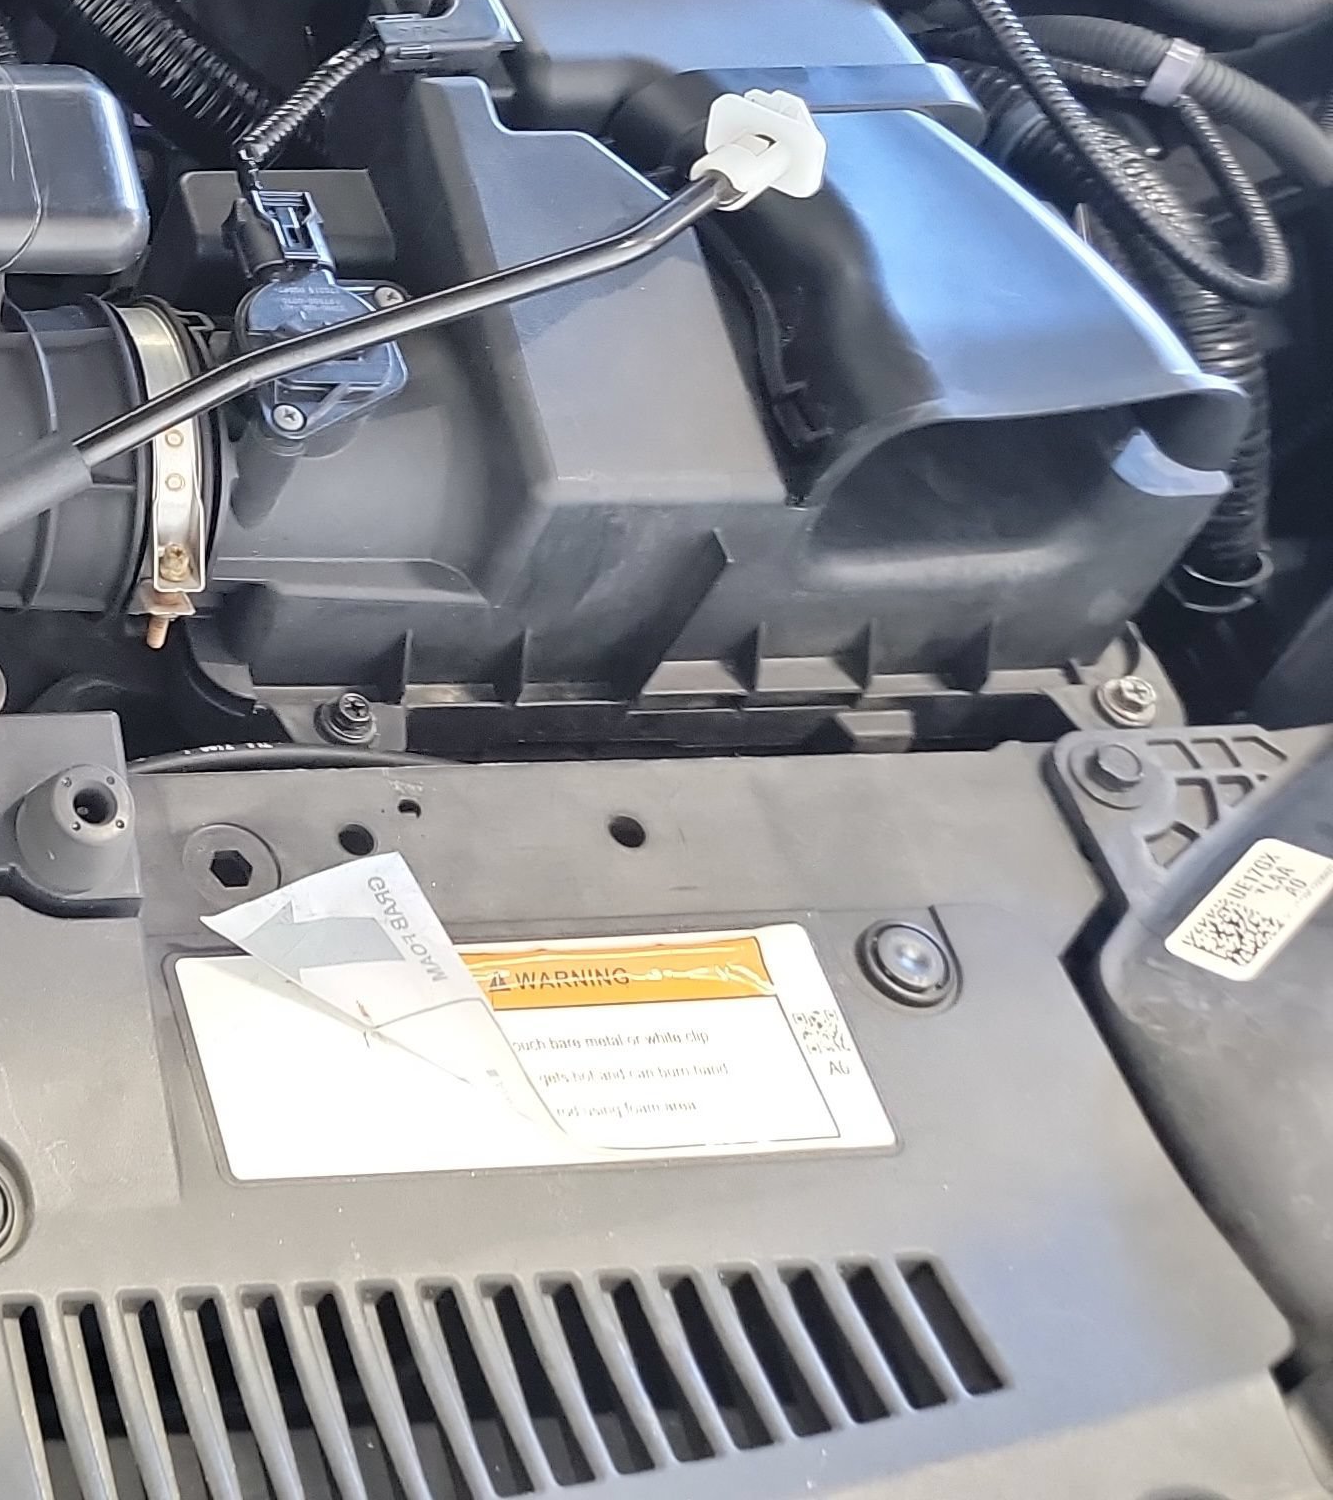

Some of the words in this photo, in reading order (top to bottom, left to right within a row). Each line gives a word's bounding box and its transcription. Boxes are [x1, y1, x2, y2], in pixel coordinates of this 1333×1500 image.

[515, 967, 630, 990] WARNING
[513, 1039, 546, 1052] ouch
[550, 1037, 581, 1050] bare
[585, 1035, 623, 1047] metal
[628, 1035, 640, 1045] or
[647, 1032, 681, 1045] white
[686, 1029, 709, 1044] clip
